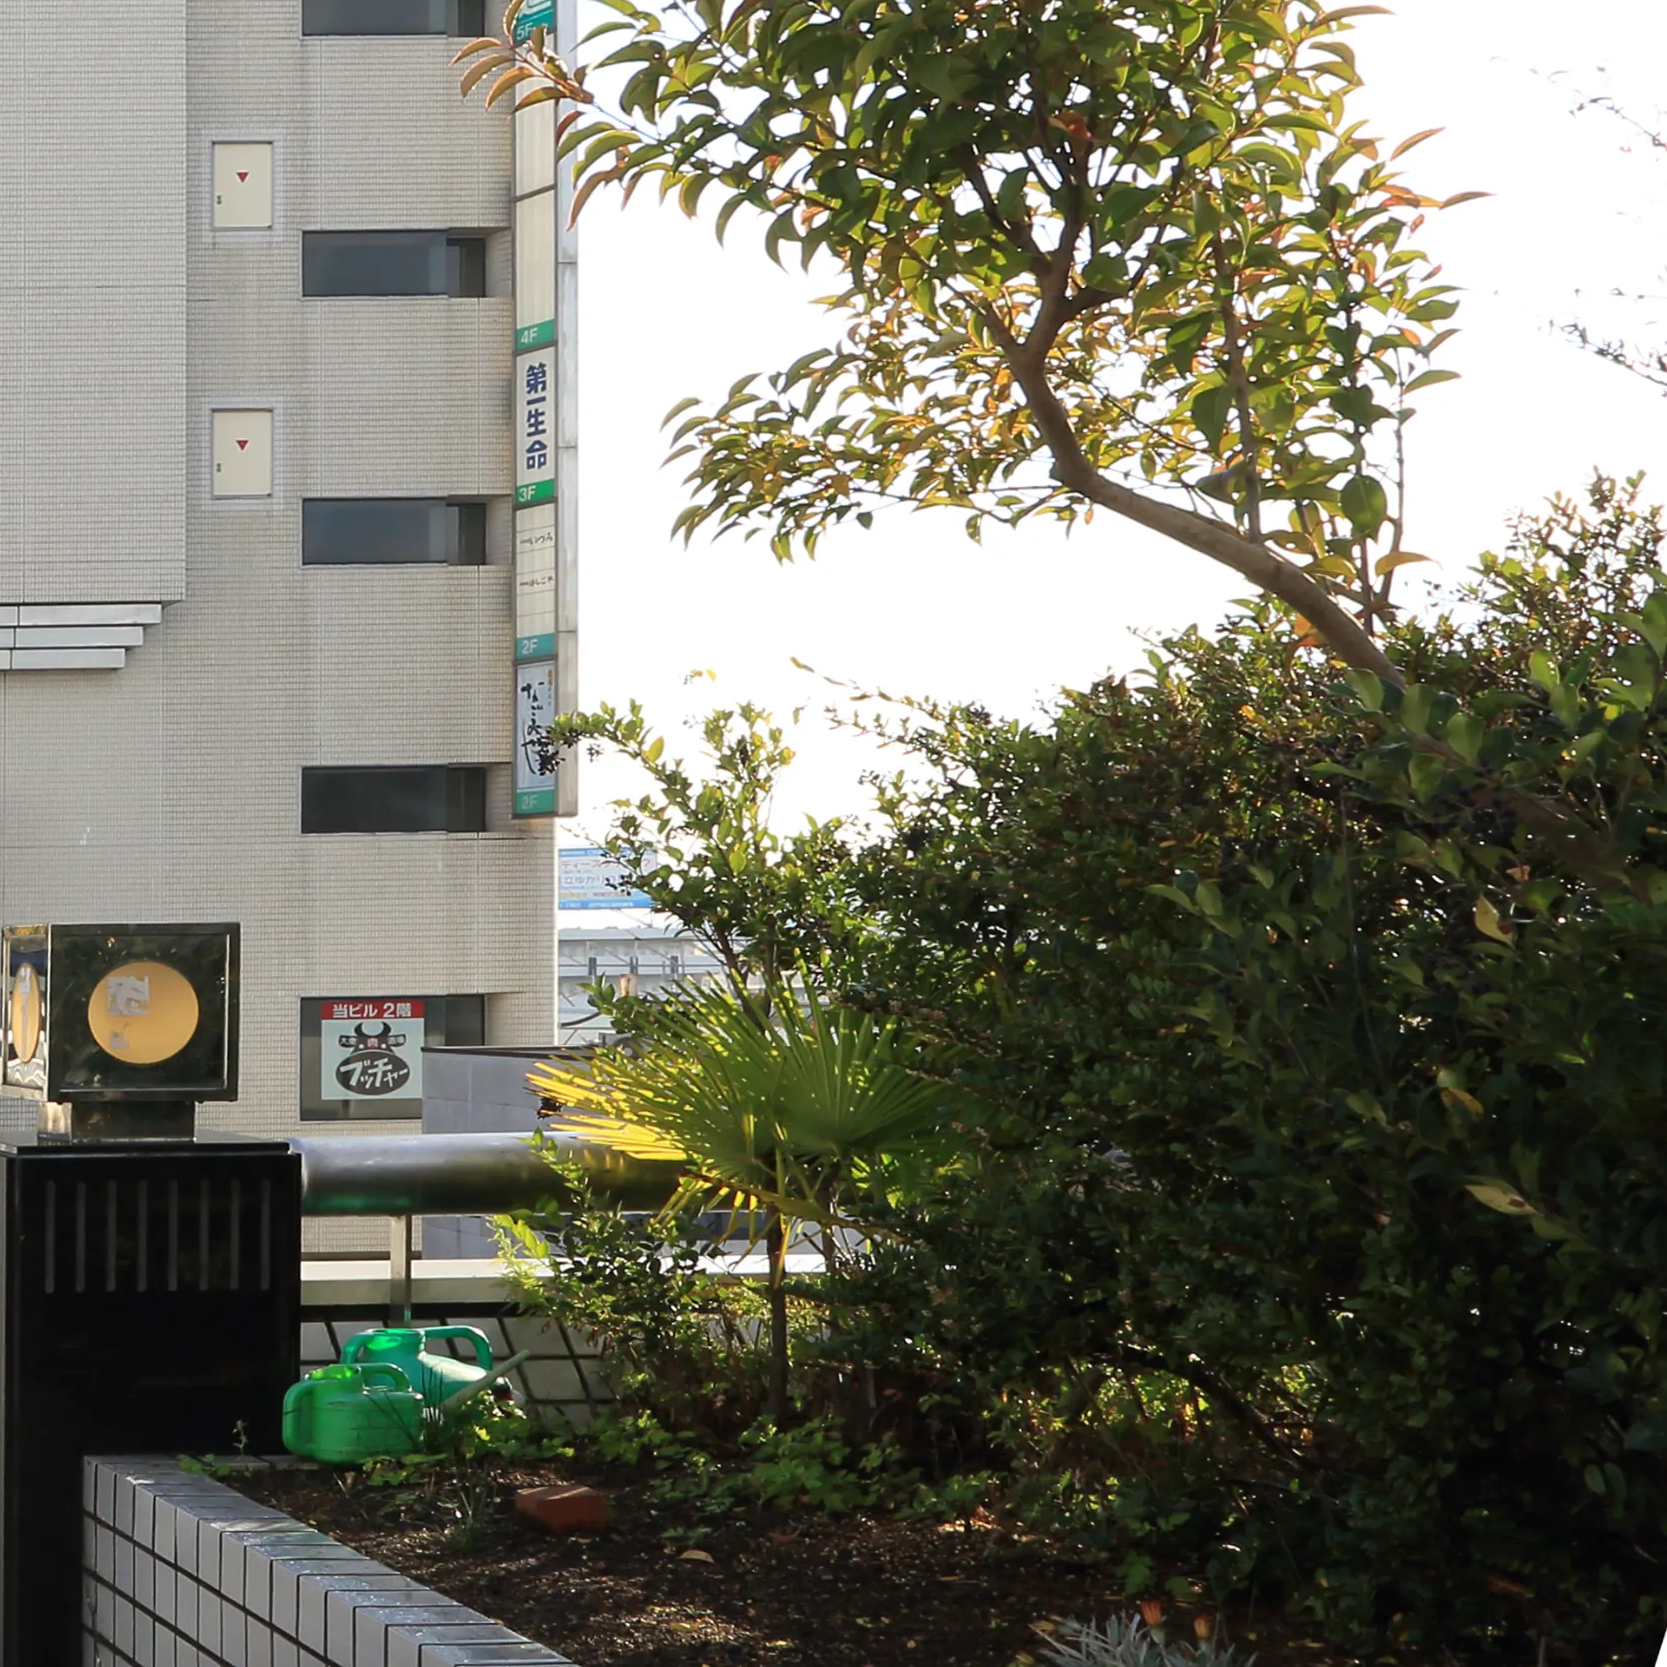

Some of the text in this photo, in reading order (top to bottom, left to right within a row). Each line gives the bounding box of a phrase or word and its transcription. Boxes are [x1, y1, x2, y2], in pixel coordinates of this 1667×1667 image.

[520, 327, 539, 344] 4F
[525, 362, 549, 470] 第一生命
[518, 485, 537, 503] 3F
[521, 638, 539, 655] 2F
[521, 794, 539, 810] 2F
[332, 1002, 412, 1019] 当ビル 2階
[339, 1057, 409, 1090] ブッチャー
